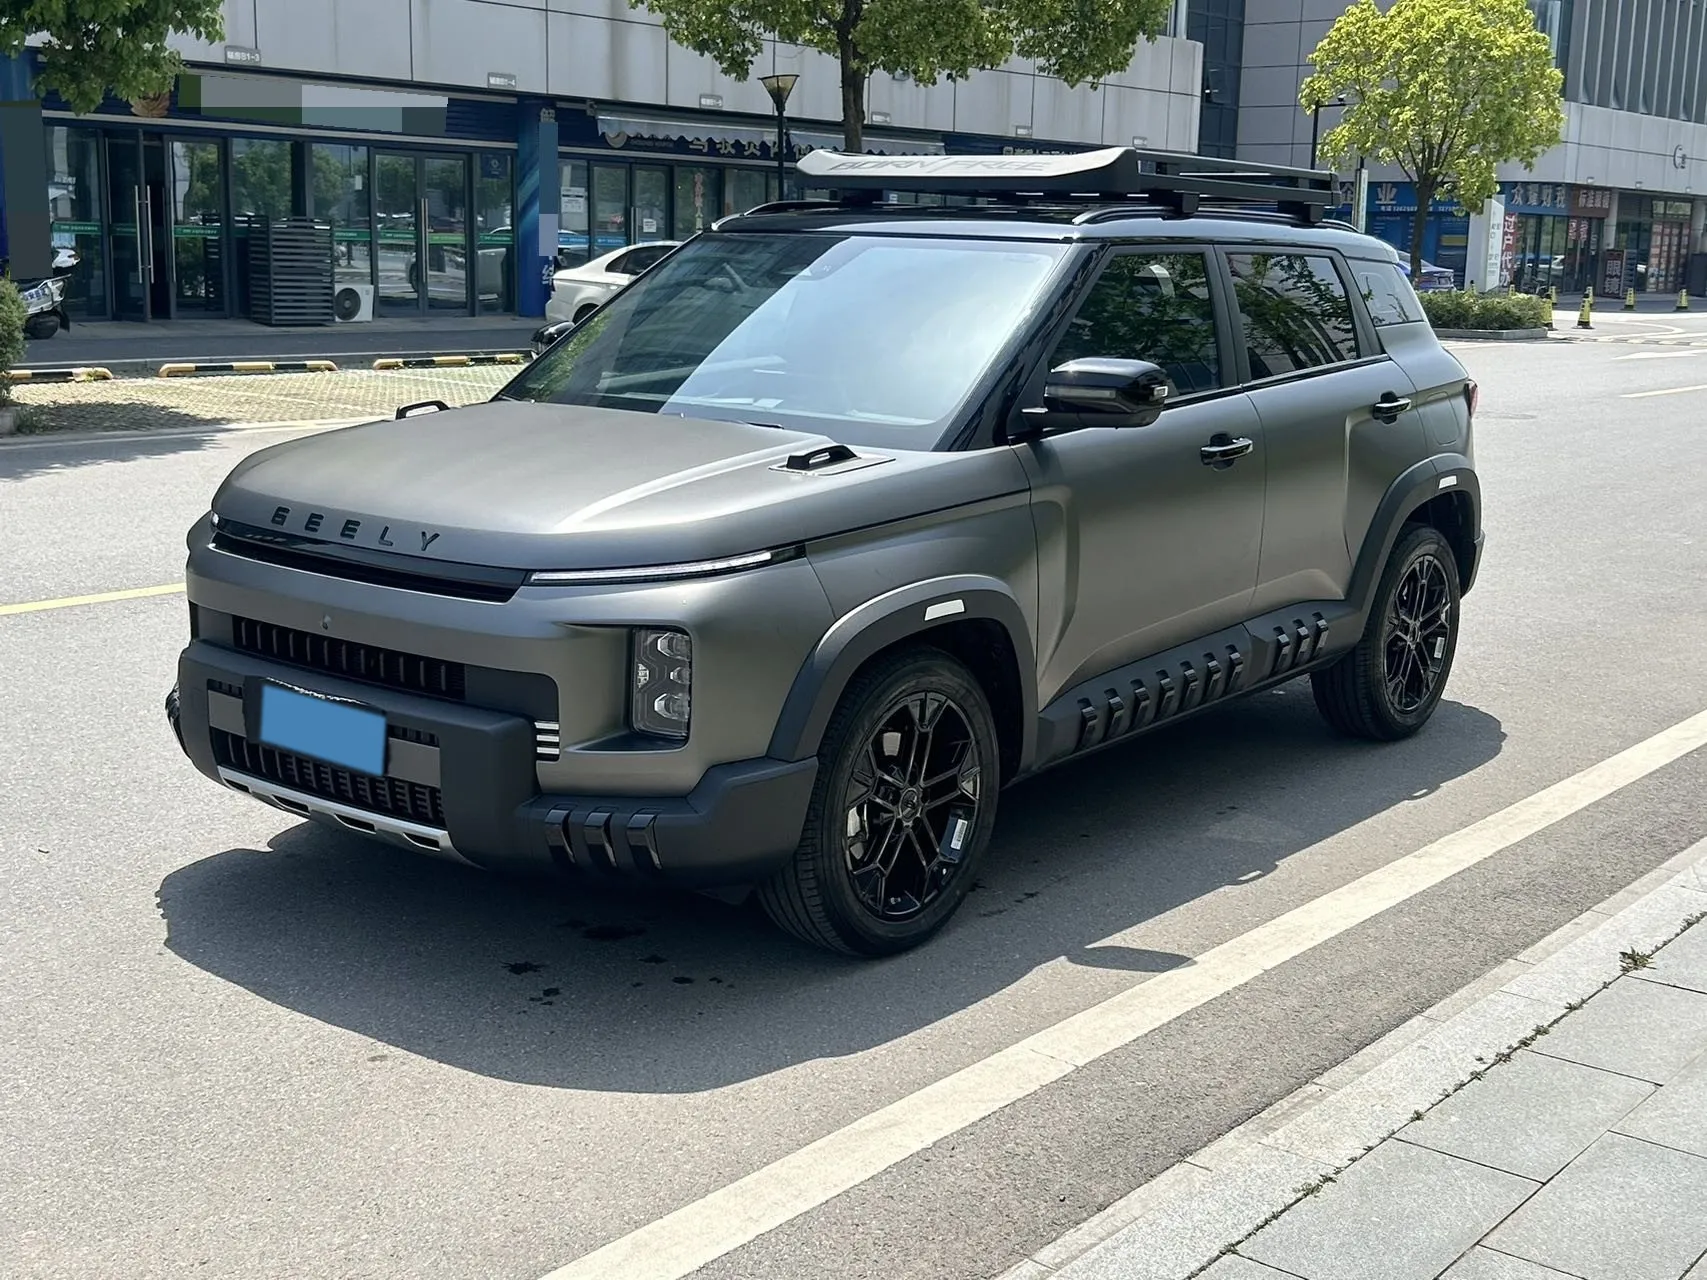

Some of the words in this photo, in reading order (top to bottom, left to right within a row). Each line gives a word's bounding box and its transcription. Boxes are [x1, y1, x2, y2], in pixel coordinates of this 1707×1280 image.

[1500, 214, 1517, 287] 过户代办
[271, 506, 440, 551] GEELY
